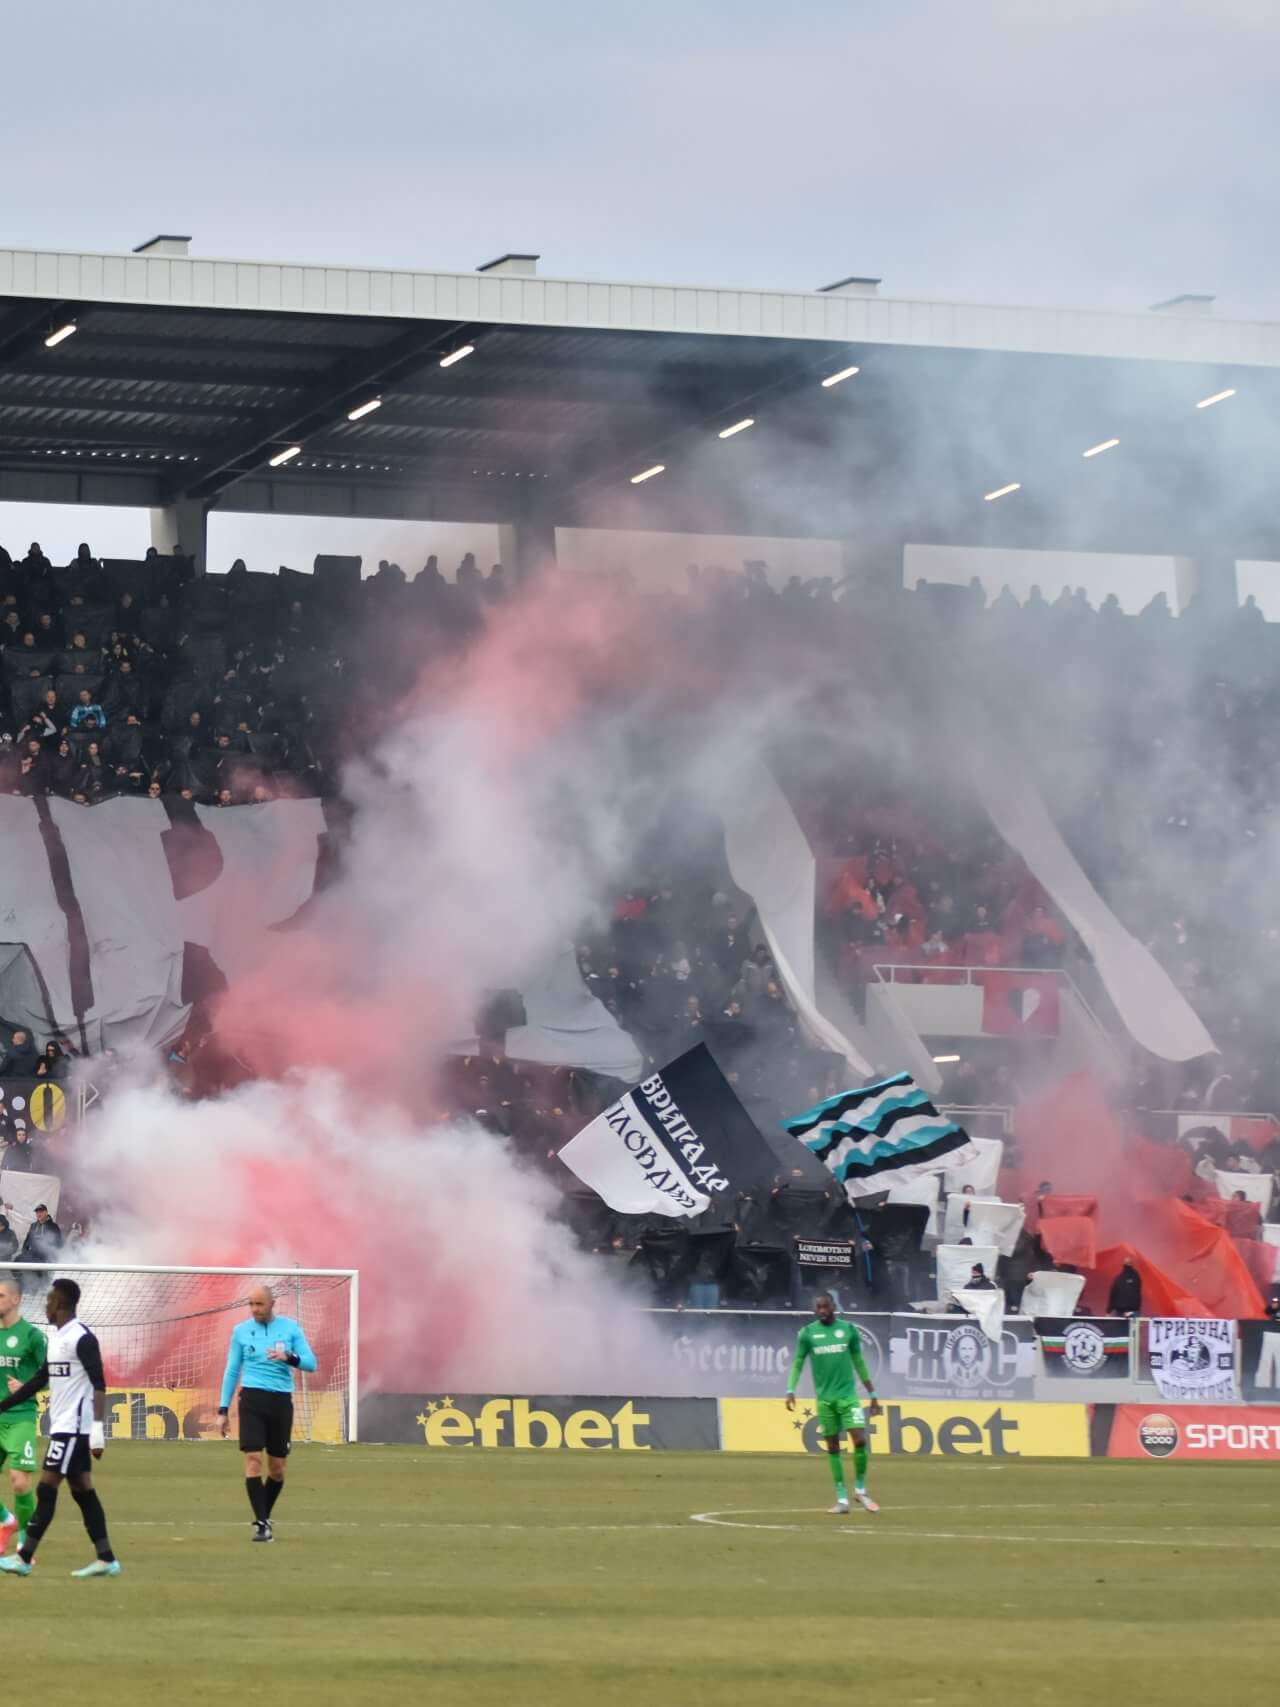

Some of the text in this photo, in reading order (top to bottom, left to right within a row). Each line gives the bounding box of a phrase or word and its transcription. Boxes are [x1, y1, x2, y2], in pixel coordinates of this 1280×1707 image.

[828, 1255, 851, 1263] ENDS
[1153, 1320, 1231, 1344] ТРИБУНА
[424, 1398, 651, 1450] efbet
[1141, 1426, 1176, 1436] SPORT
[24, 1440, 33, 1459] 6
[1144, 1436, 1173, 1444] 2000
[47, 1440, 65, 1461] 15
